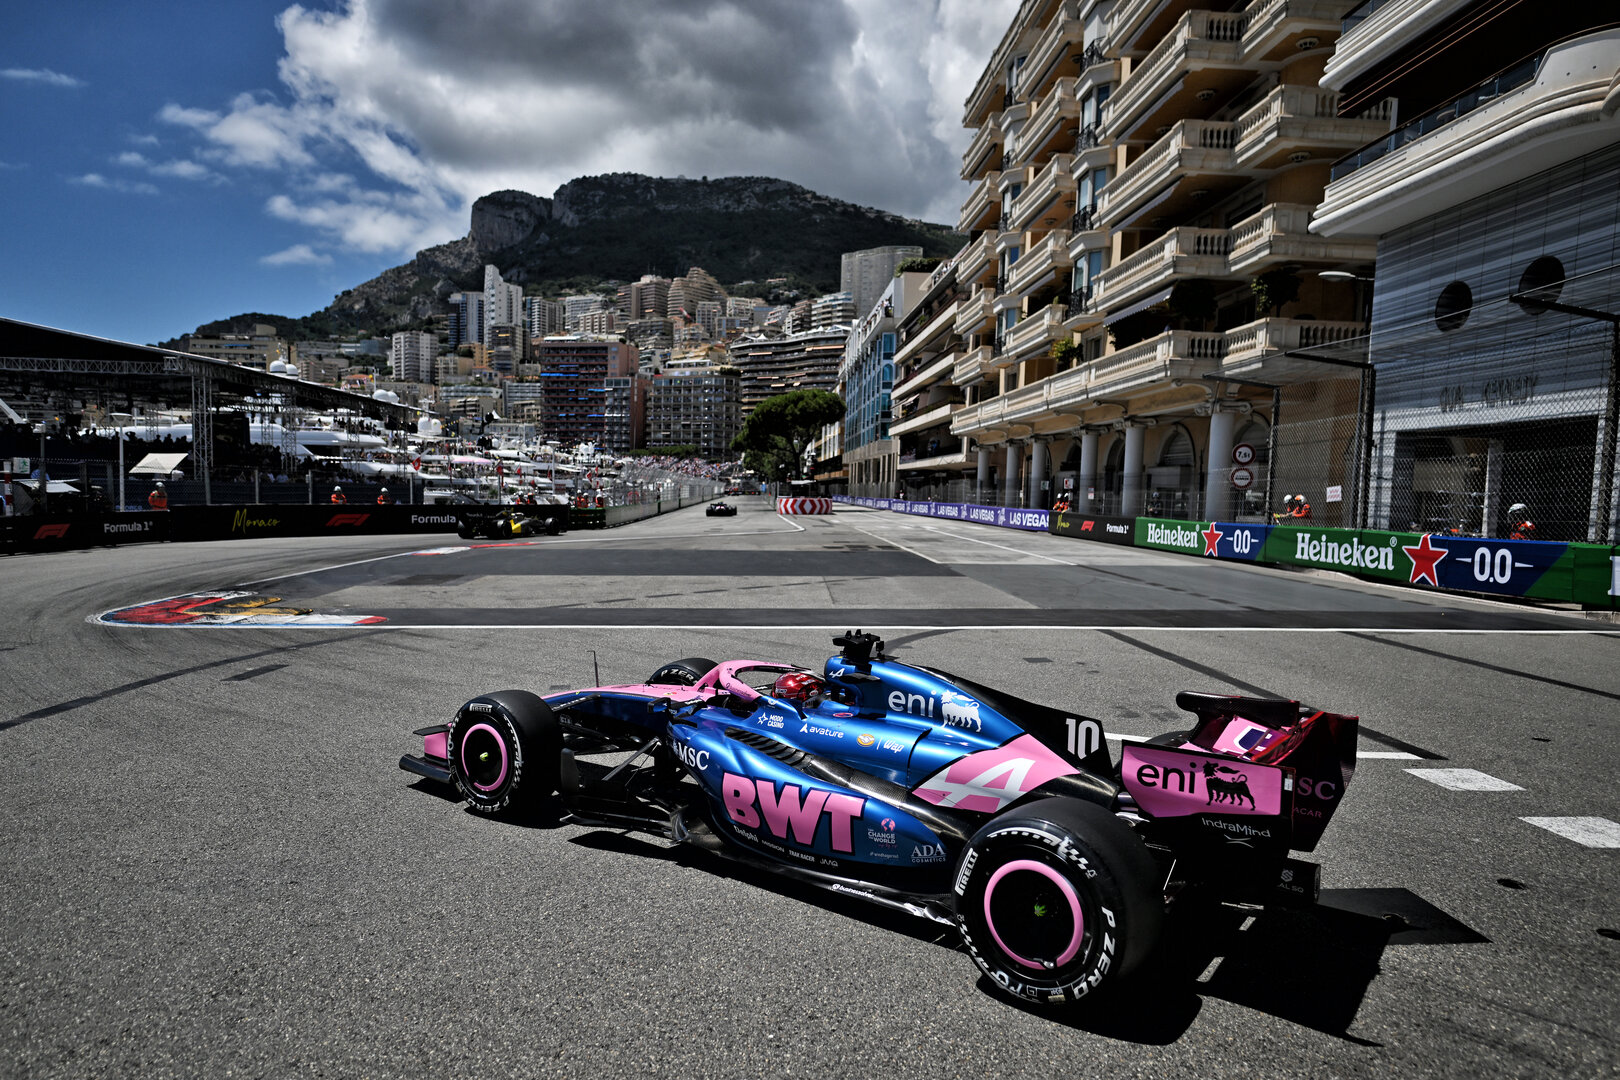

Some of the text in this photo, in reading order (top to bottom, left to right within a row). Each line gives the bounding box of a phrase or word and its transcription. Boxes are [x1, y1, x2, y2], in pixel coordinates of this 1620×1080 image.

[411, 513, 457, 525] Formula
[937, 505, 958, 517] LAS VEGAS
[970, 507, 995, 523] LAS VEGAS
[1009, 512, 1021, 525] LAS
[103, 521, 142, 534] Formula
[232, 507, 281, 534] Monaco
[1233, 529, 1251, 554] 0.0
[1473, 547, 1513, 584] 0.0
[660, 669, 668, 678] P
[887, 689, 937, 718] eni
[767, 720, 785, 729] CASINO
[809, 726, 844, 739] avature
[883, 738, 905, 754] Wap
[1065, 717, 1100, 760] 10
[677, 742, 710, 771] MSC
[1136, 761, 1197, 794] eni
[1296, 777, 1336, 800] SC
[722, 771, 865, 853] BWT
[1201, 817, 1271, 838] IndraMind
[867, 831, 896, 844] CHANGE
[873, 837, 896, 845] WORLD
[800, 853, 815, 863] RACER
[910, 843, 946, 857] ADA
[954, 847, 979, 897] PIRELLI
[1073, 906, 1116, 1000] P ZERO
